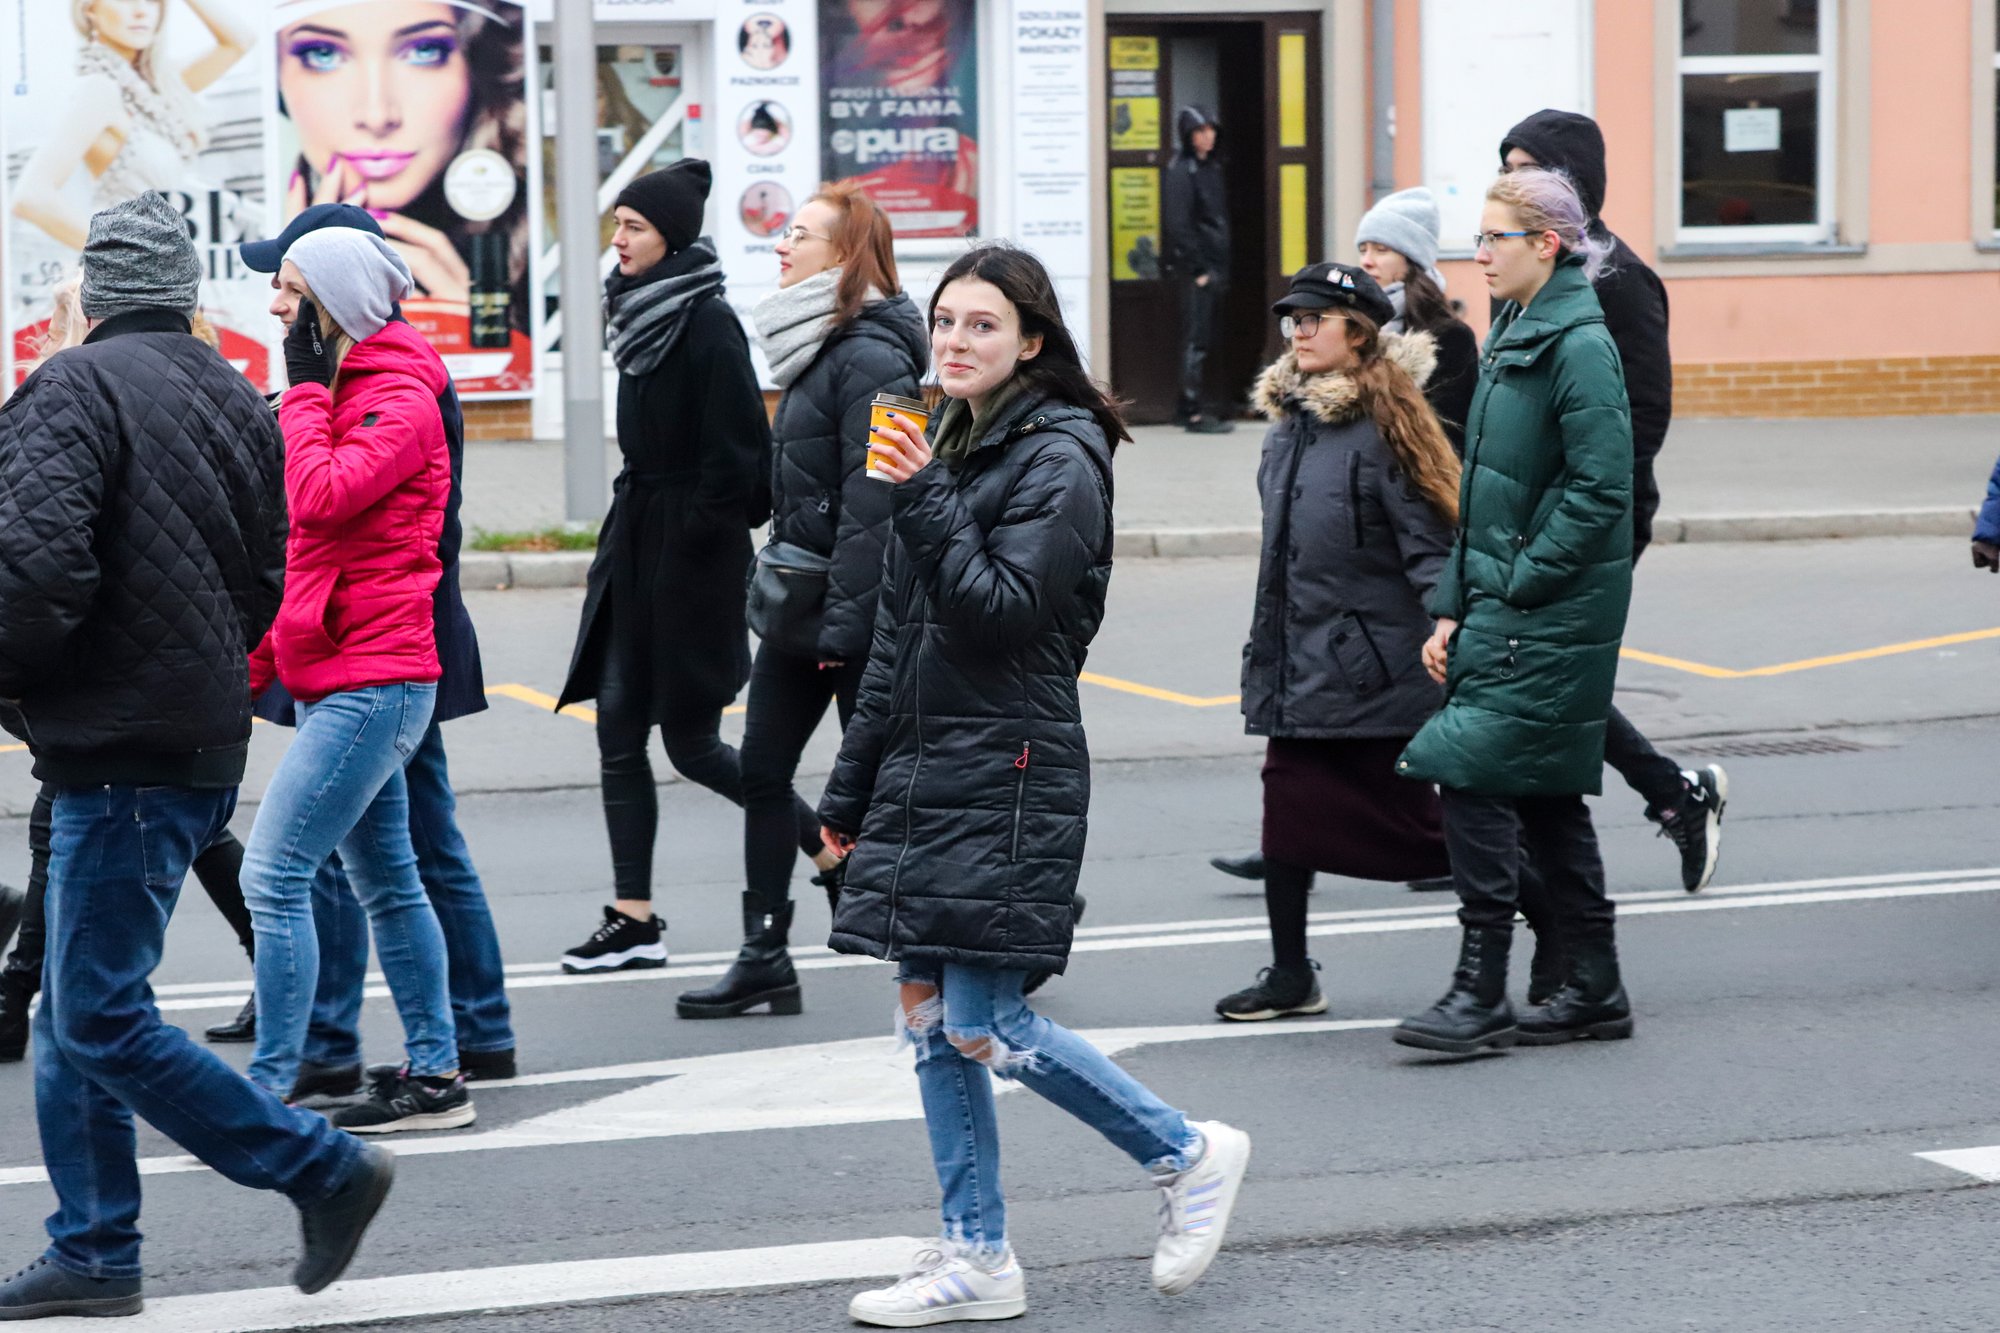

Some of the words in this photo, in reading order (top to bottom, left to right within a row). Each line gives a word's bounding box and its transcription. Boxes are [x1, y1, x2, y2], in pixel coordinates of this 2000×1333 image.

[1018, 26, 1081, 39] POKAZY
[730, 77, 800, 86] PAZNOKCIE
[830, 101, 869, 118] BY
[879, 100, 963, 117] FAMA
[745, 244, 776, 254] SPRZ
